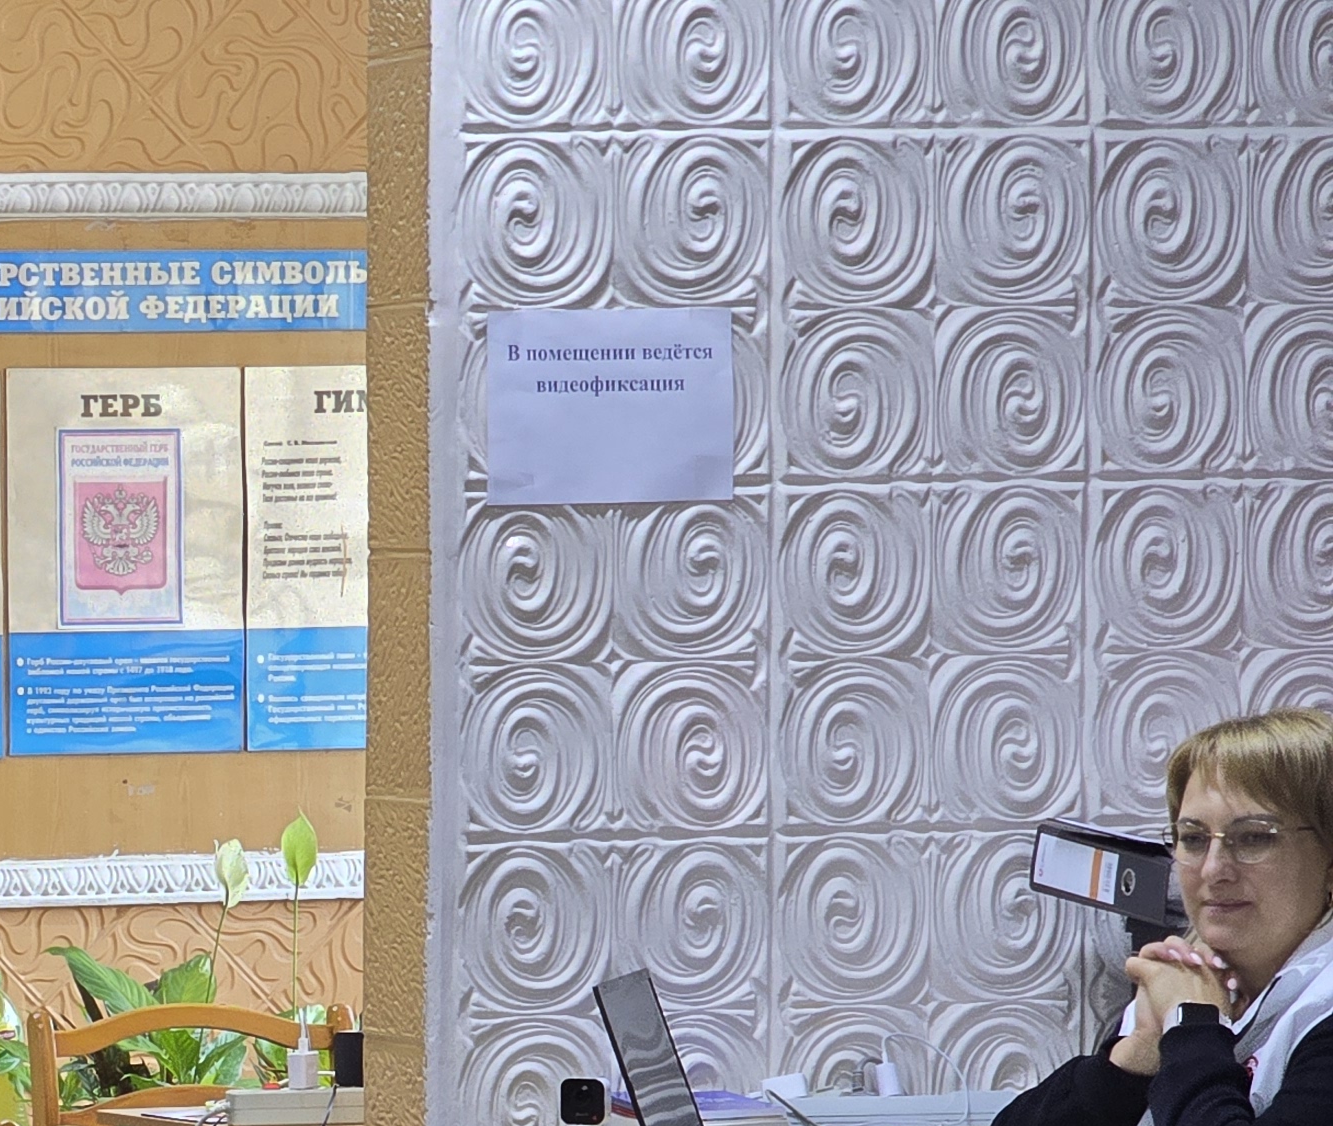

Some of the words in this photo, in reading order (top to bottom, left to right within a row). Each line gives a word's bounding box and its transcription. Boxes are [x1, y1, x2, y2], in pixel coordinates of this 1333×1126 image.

[139, 293, 340, 323] ФЕДЕРАЦИИ
[507, 344, 520, 361] В
[526, 347, 635, 362] помещении
[642, 344, 713, 362] ведётся
[536, 376, 685, 396] видеофиксация
[80, 394, 163, 418] ГЕРБ
[71, 442, 148, 454] ГОСУДАРСТВЕННЫЙ
[150, 443, 168, 453] ГЕРБ
[71, 456, 122, 467] РОССИЙСКОЙ
[124, 457, 169, 468] ФЕДЕРАЦИИ
